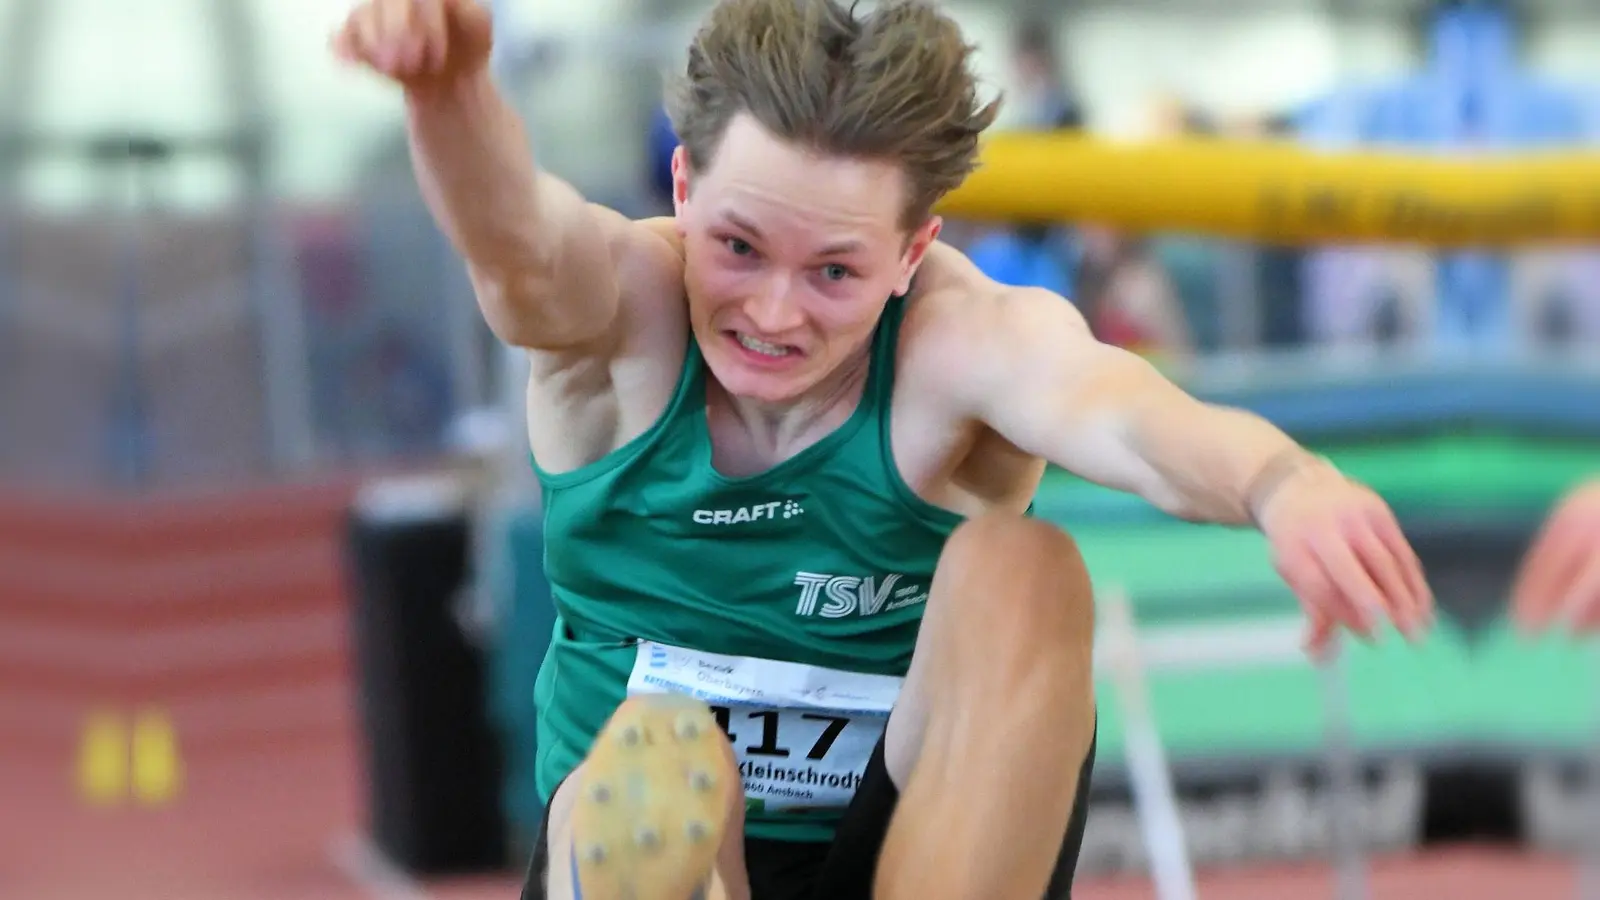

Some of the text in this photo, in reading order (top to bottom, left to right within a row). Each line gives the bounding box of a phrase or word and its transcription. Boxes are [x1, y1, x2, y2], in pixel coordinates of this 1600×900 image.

[692, 501, 782, 525] CRAFT
[794, 571, 904, 618] TSV
[696, 671, 765, 698] Oberbayern
[767, 784, 814, 799] Ansbach
